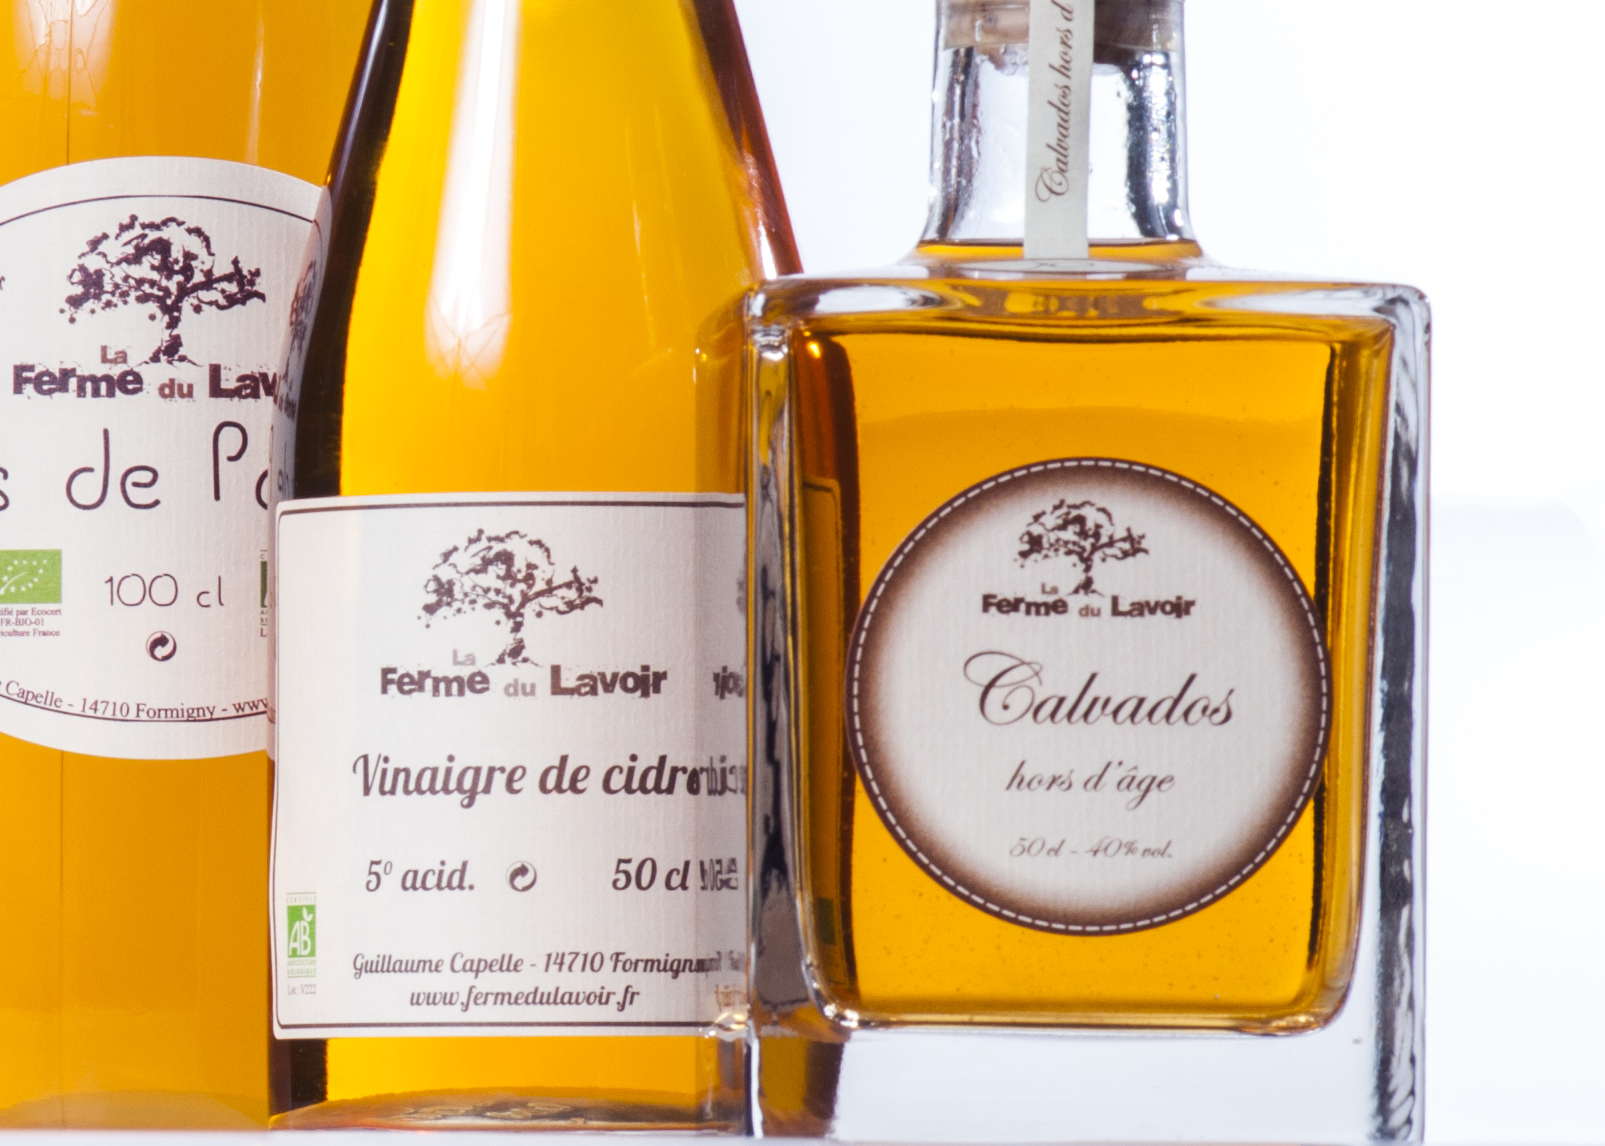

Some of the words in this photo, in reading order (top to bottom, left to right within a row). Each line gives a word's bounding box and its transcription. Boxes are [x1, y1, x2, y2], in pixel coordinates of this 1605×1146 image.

[1049, 27, 1074, 80] hors
[1035, 85, 1072, 204] Calvados
[100, 344, 128, 365] La
[12, 364, 144, 399] Ferme
[158, 378, 195, 399] du
[66, 428, 161, 511] de
[104, 573, 179, 607] 100
[196, 575, 225, 608] cl
[982, 594, 1069, 617] Ferme
[1078, 603, 1102, 618] du
[1111, 594, 1196, 619] Lavoir
[1040, 582, 1059, 596] La
[32, 628, 61, 637] France
[452, 649, 476, 667] La
[380, 666, 491, 698] Ferme
[503, 678, 537, 698] du
[550, 664, 668, 699] Lavoir
[963, 651, 1234, 726] Calvados
[5, 680, 63, 710] Capelle
[80, 697, 130, 719] 14710
[135, 702, 216, 722] Formigny
[352, 754, 527, 809] Vinaigre
[538, 753, 592, 796] de
[1005, 760, 1074, 792] hors
[1083, 760, 1175, 811] d'âge
[1009, 837, 1045, 858] 50
[1085, 836, 1139, 858] 40%
[400, 859, 475, 892] acid.
[611, 857, 658, 892] 50
[664, 859, 692, 892] cl
[352, 952, 444, 980] Guillaume
[450, 952, 524, 979] Capelle
[543, 952, 605, 974] 14710
[409, 985, 641, 1012] www.fermedulavoir.fr
